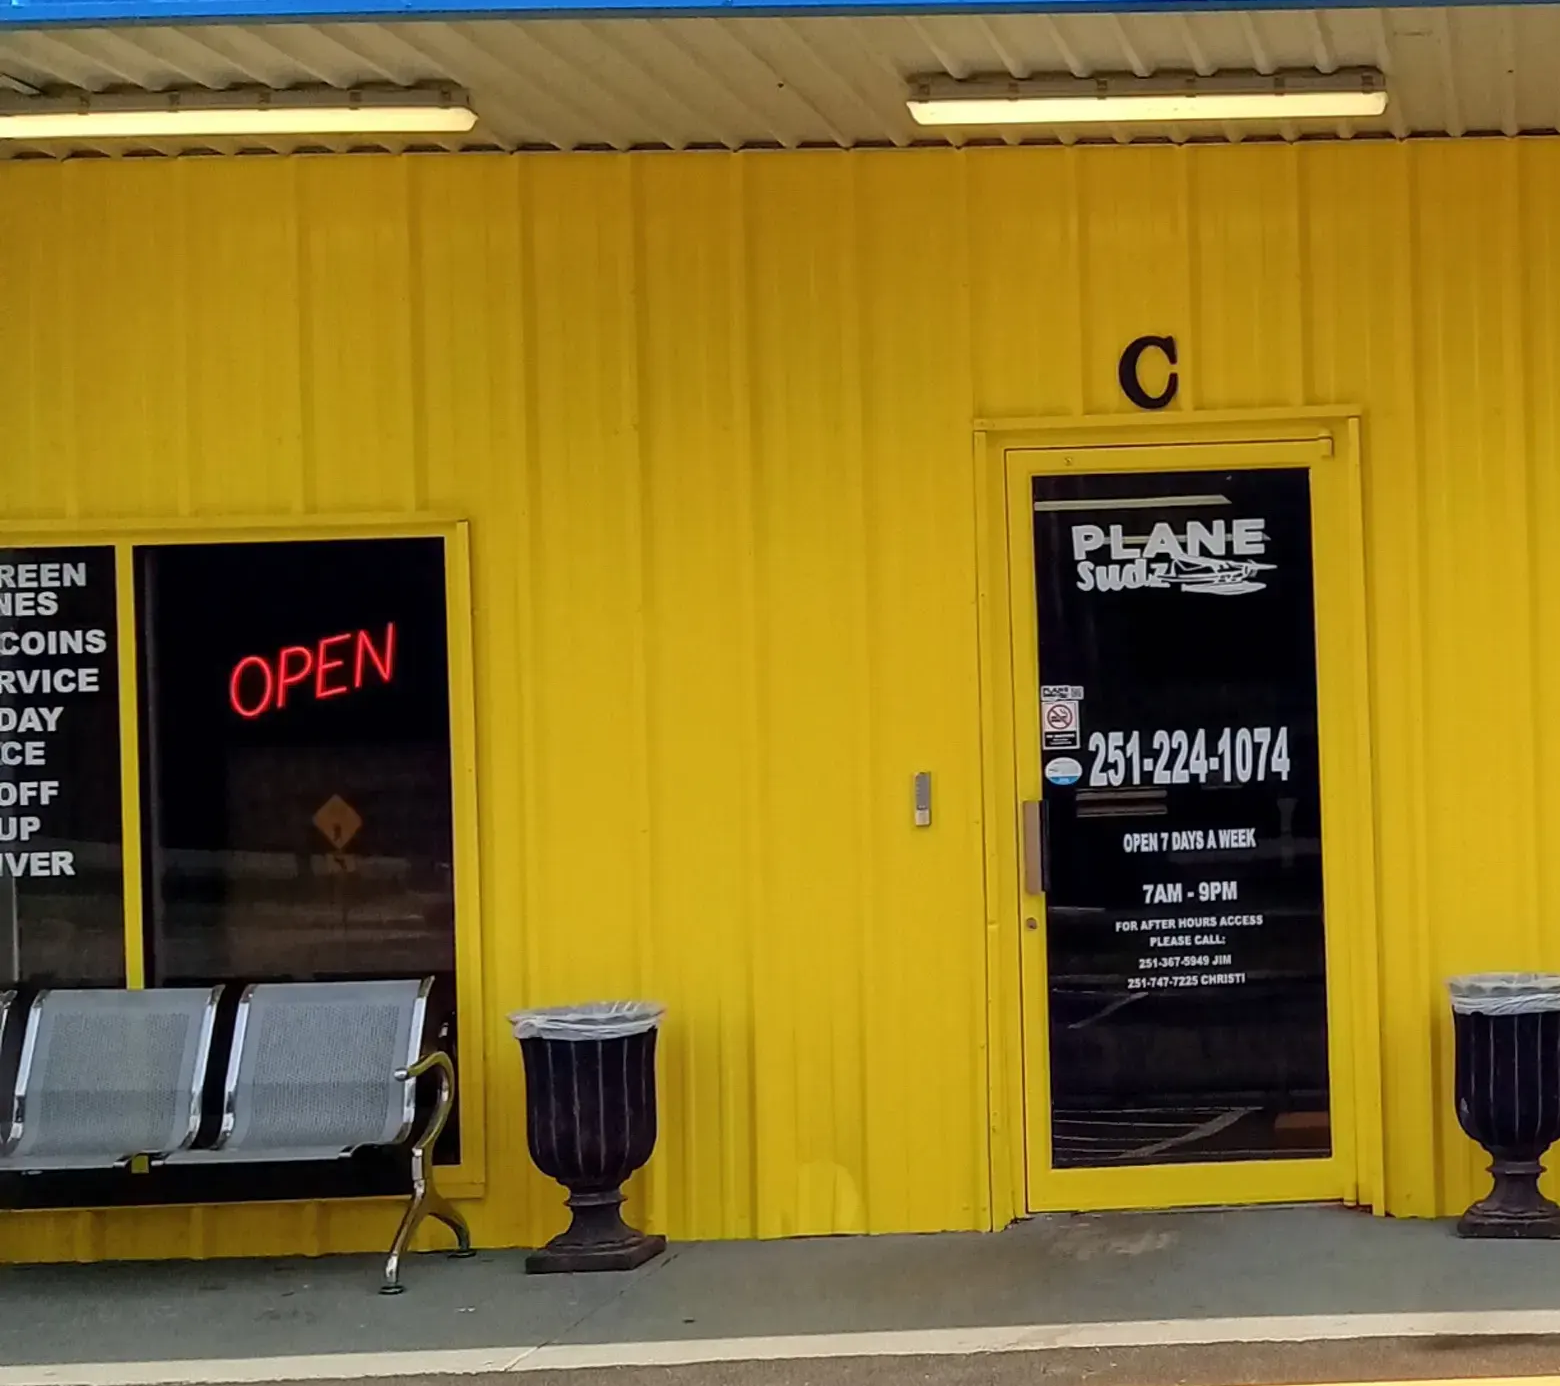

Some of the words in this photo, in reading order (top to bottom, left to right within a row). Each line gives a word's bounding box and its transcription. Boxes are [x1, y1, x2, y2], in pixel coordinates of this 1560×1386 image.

[1118, 335, 1178, 409] C
[1071, 518, 1266, 560] PLANE
[0, 629, 107, 656] COINS
[230, 622, 396, 718] OPEN
[1088, 727, 1290, 787] 251-224-1074
[1123, 833, 1158, 853] OPEN
[1160, 832, 1169, 851] 7
[1172, 831, 1204, 851] DAYS
[1206, 829, 1217, 849] A
[1218, 828, 1257, 849] WEEK
[1143, 883, 1183, 904] 7AM
[1198, 881, 1238, 902] 9PM
[1115, 921, 1138, 932] FOR
[1140, 919, 1176, 931] AFTER
[1178, 917, 1217, 929] HOURS
[1219, 915, 1263, 927] ACCESS
[1150, 935, 1191, 947] PLEASE
[1194, 934, 1225, 946] CALL:
[1212, 954, 1232, 966] JIM
[1127, 976, 1198, 989] 251-747-7225
[1200, 973, 1245, 986] CHRISTI
